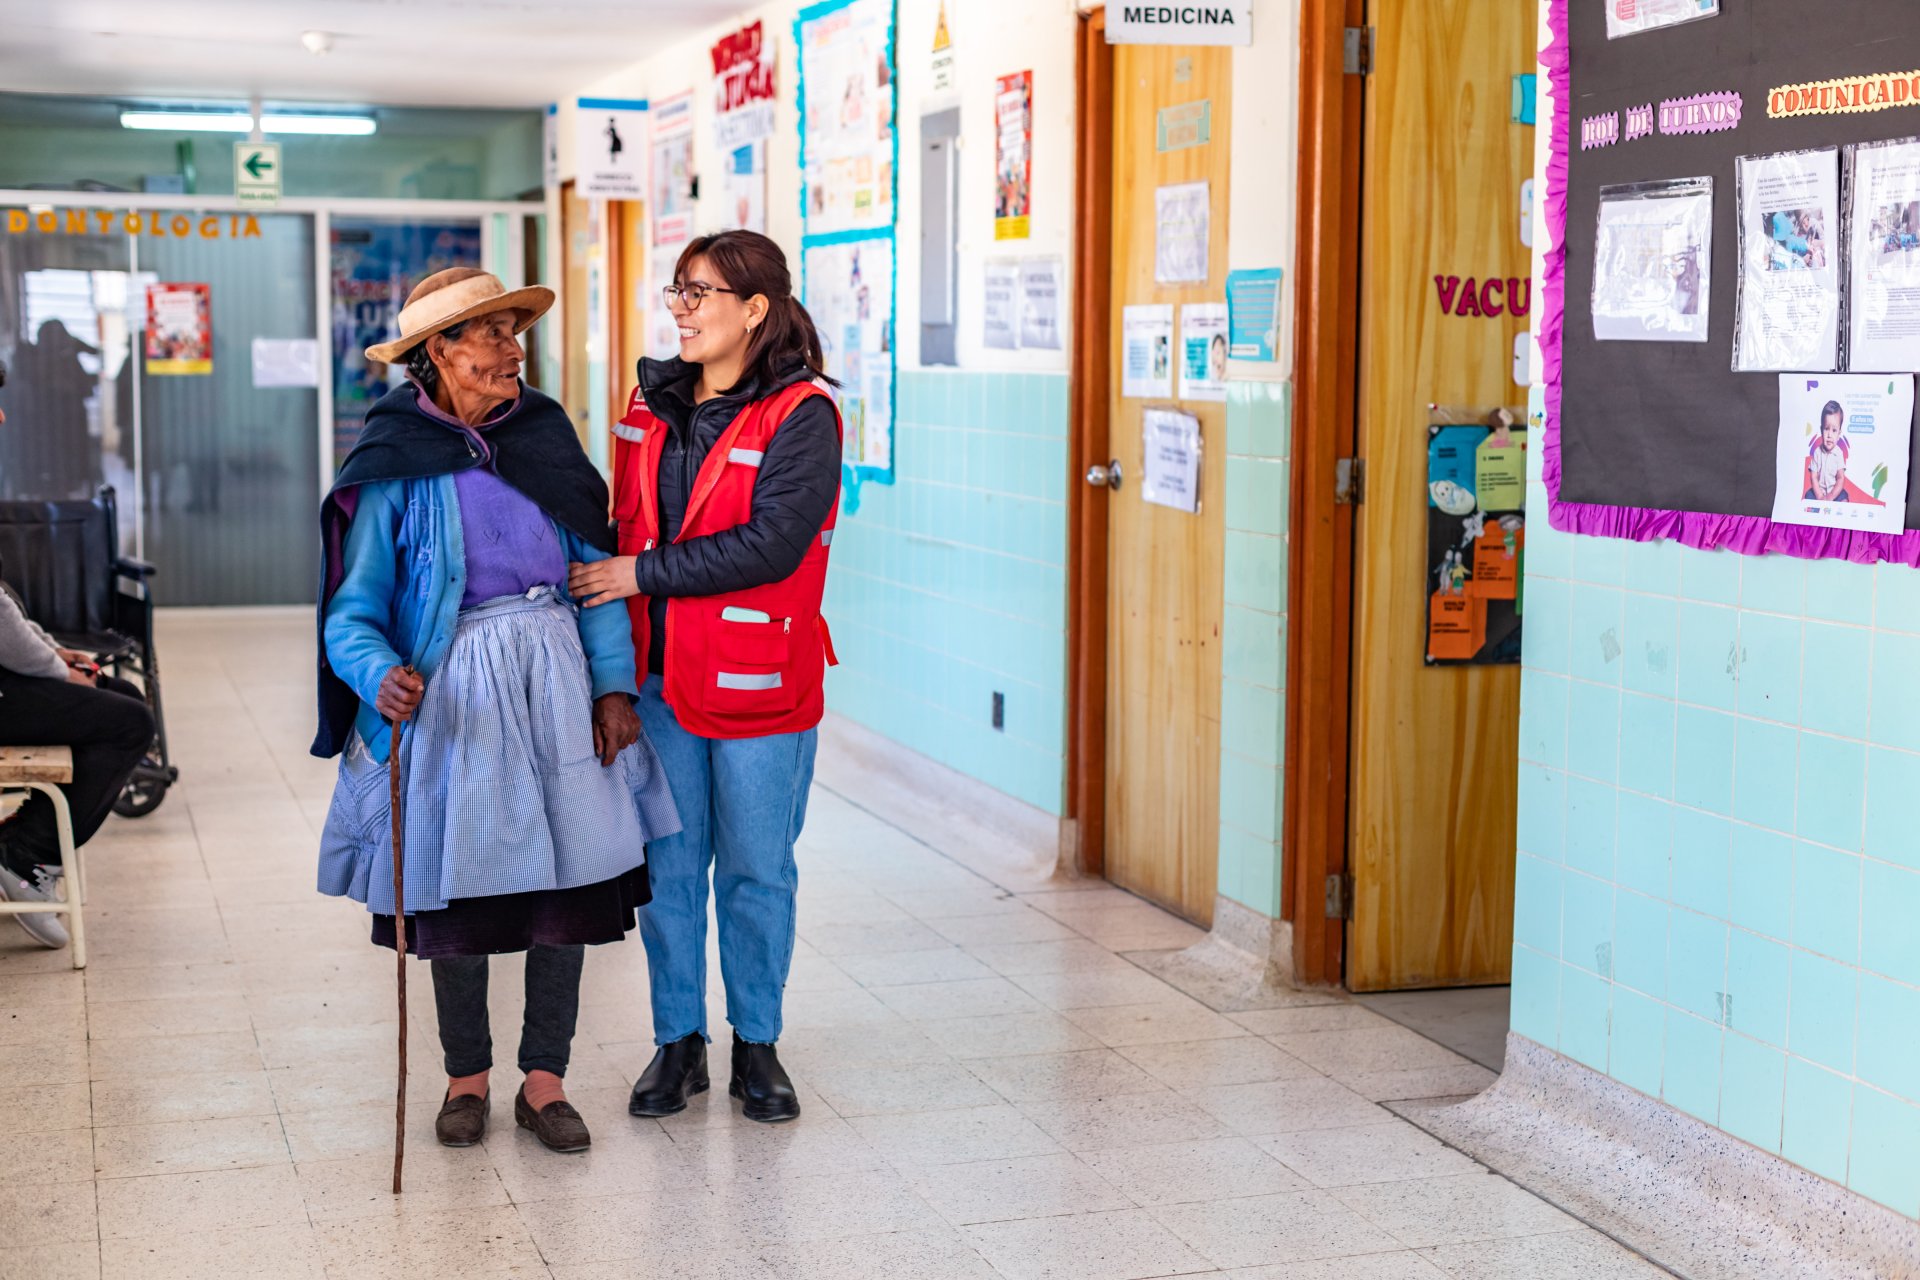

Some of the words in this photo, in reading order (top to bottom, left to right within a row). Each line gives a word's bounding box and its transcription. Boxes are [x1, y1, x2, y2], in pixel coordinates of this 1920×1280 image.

[1124, 7, 1235, 24] MEDICINA
[1584, 117, 1617, 142] ROL
[1628, 109, 1652, 134] DE
[1660, 100, 1738, 128] TURNOS
[7, 209, 262, 239] DONTOLOGIA
[1433, 274, 1531, 318] VACU
